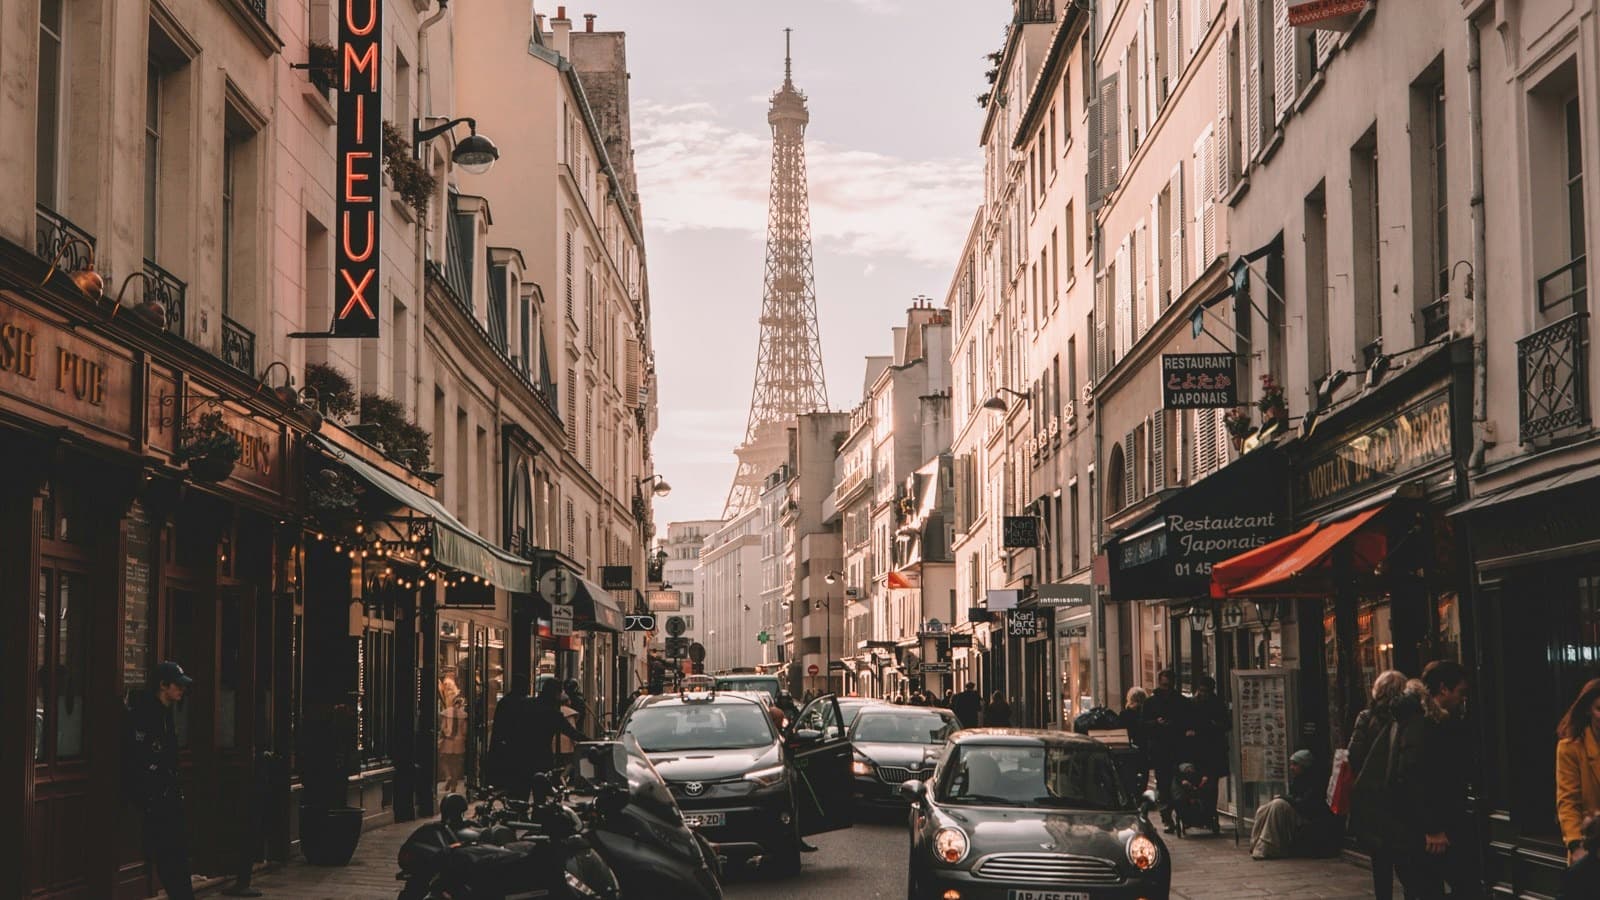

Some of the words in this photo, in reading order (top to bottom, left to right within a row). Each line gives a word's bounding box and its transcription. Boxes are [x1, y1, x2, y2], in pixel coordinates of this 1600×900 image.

[1164, 356, 1233, 370] RESTAURANT
[56, 346, 108, 407] PUB
[1171, 392, 1228, 405] JAPONAIS
[1309, 456, 1350, 498] MOULIN
[1353, 446, 1371, 483] DE
[1374, 433, 1395, 473] LA
[1396, 402, 1450, 465] VIERGE
[1167, 512, 1275, 532] Restaurant
[1180, 533, 1266, 556] Japonais
[1175, 563, 1190, 576] 01
[1195, 562, 1212, 575] 45
[1013, 611, 1035, 620] Karl
[1009, 618, 1035, 628] Marc
[1009, 626, 1035, 635] John
